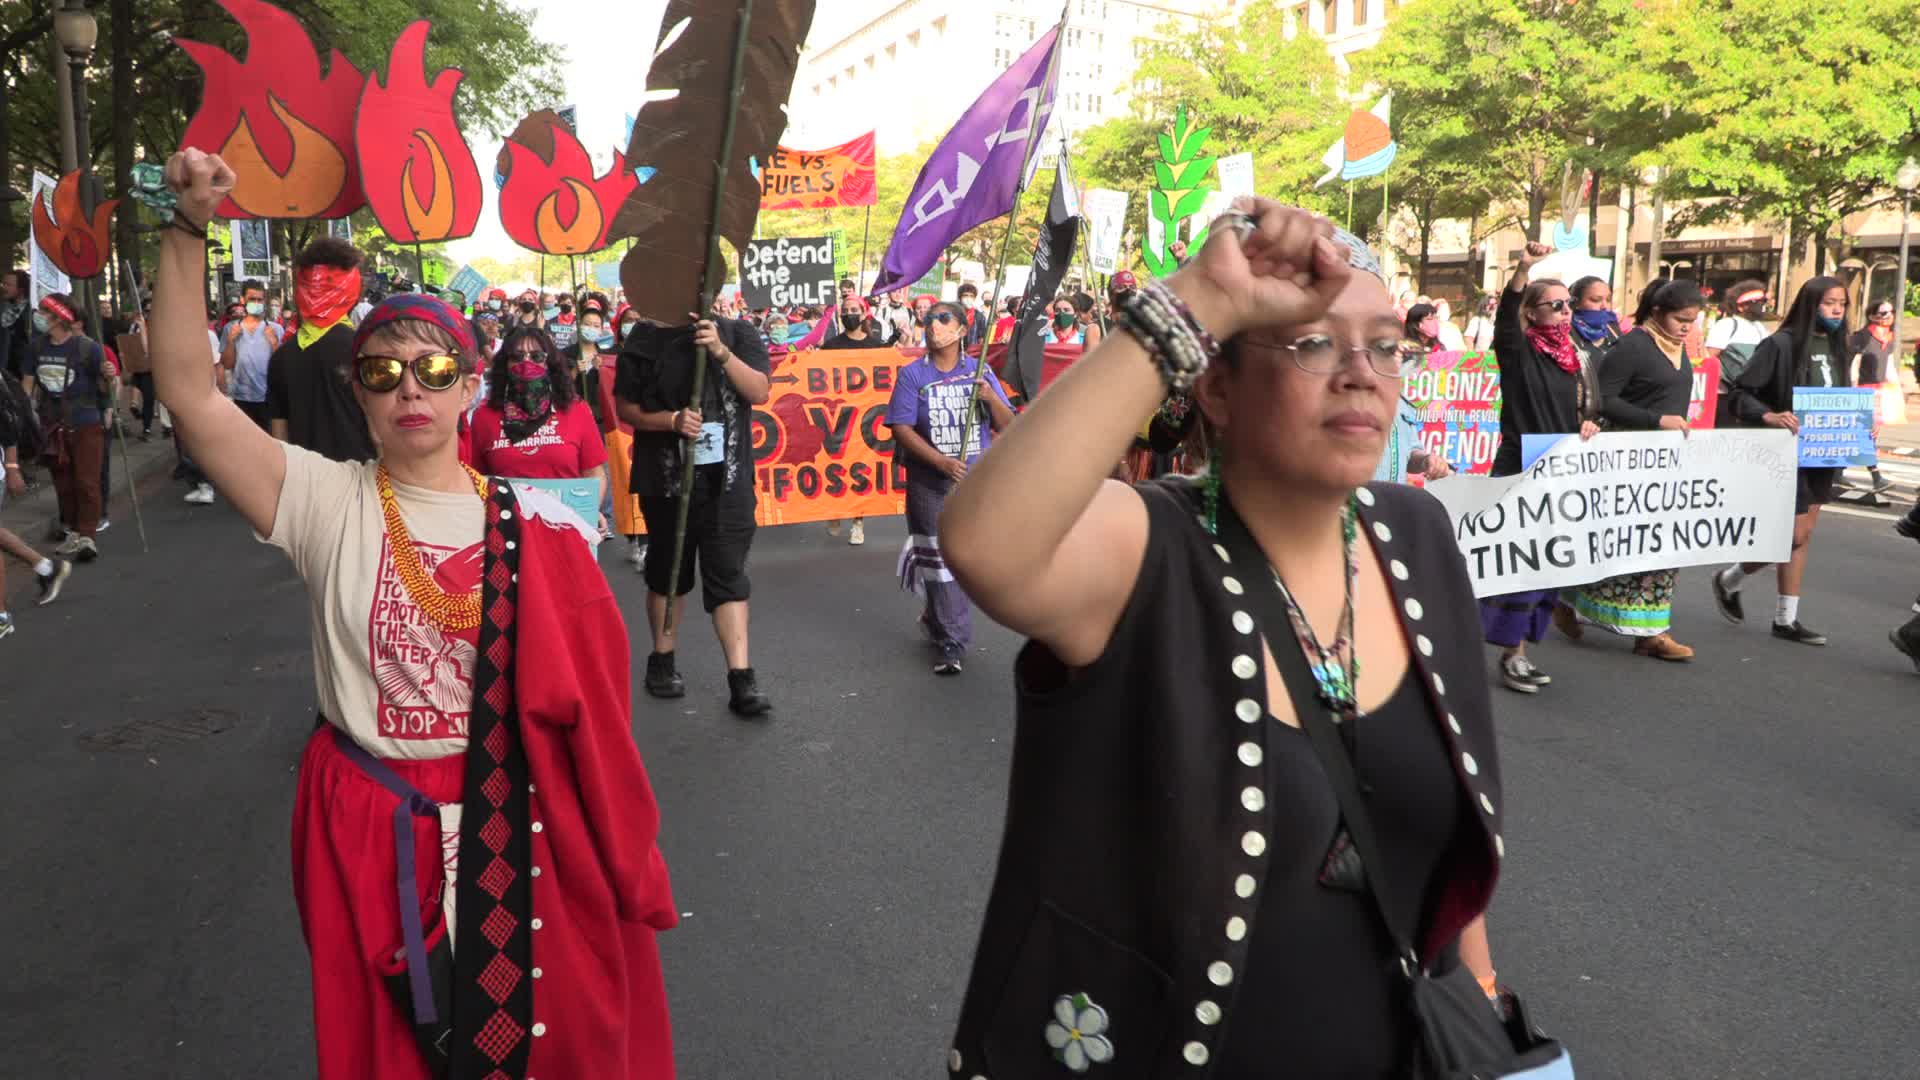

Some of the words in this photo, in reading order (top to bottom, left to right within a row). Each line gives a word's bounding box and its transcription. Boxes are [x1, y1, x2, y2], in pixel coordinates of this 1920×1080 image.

[763, 170, 834, 196] FUELS
[743, 238, 832, 269] Defend
[747, 263, 790, 289] the
[770, 280, 835, 307] GULF
[807, 365, 904, 394] BIDE
[928, 397, 944, 410] BE
[945, 396, 970, 410] QUIE
[928, 409, 949, 427] SO
[1804, 414, 1857, 429] REJECT
[931, 427, 961, 444] CAN
[1532, 449, 1624, 480] RESIDENT
[1802, 447, 1860, 458] PROJECTS
[773, 461, 908, 500] FOSSIL
[1457, 502, 1506, 541] NO
[1614, 478, 1725, 516] EXCUSES:
[1470, 535, 1577, 580] TING
[1587, 522, 1663, 565] RGHTS
[1672, 516, 1757, 552] NOW!
[375, 621, 407, 643] THE
[376, 642, 430, 665] WATER
[383, 707, 437, 736] STOP
